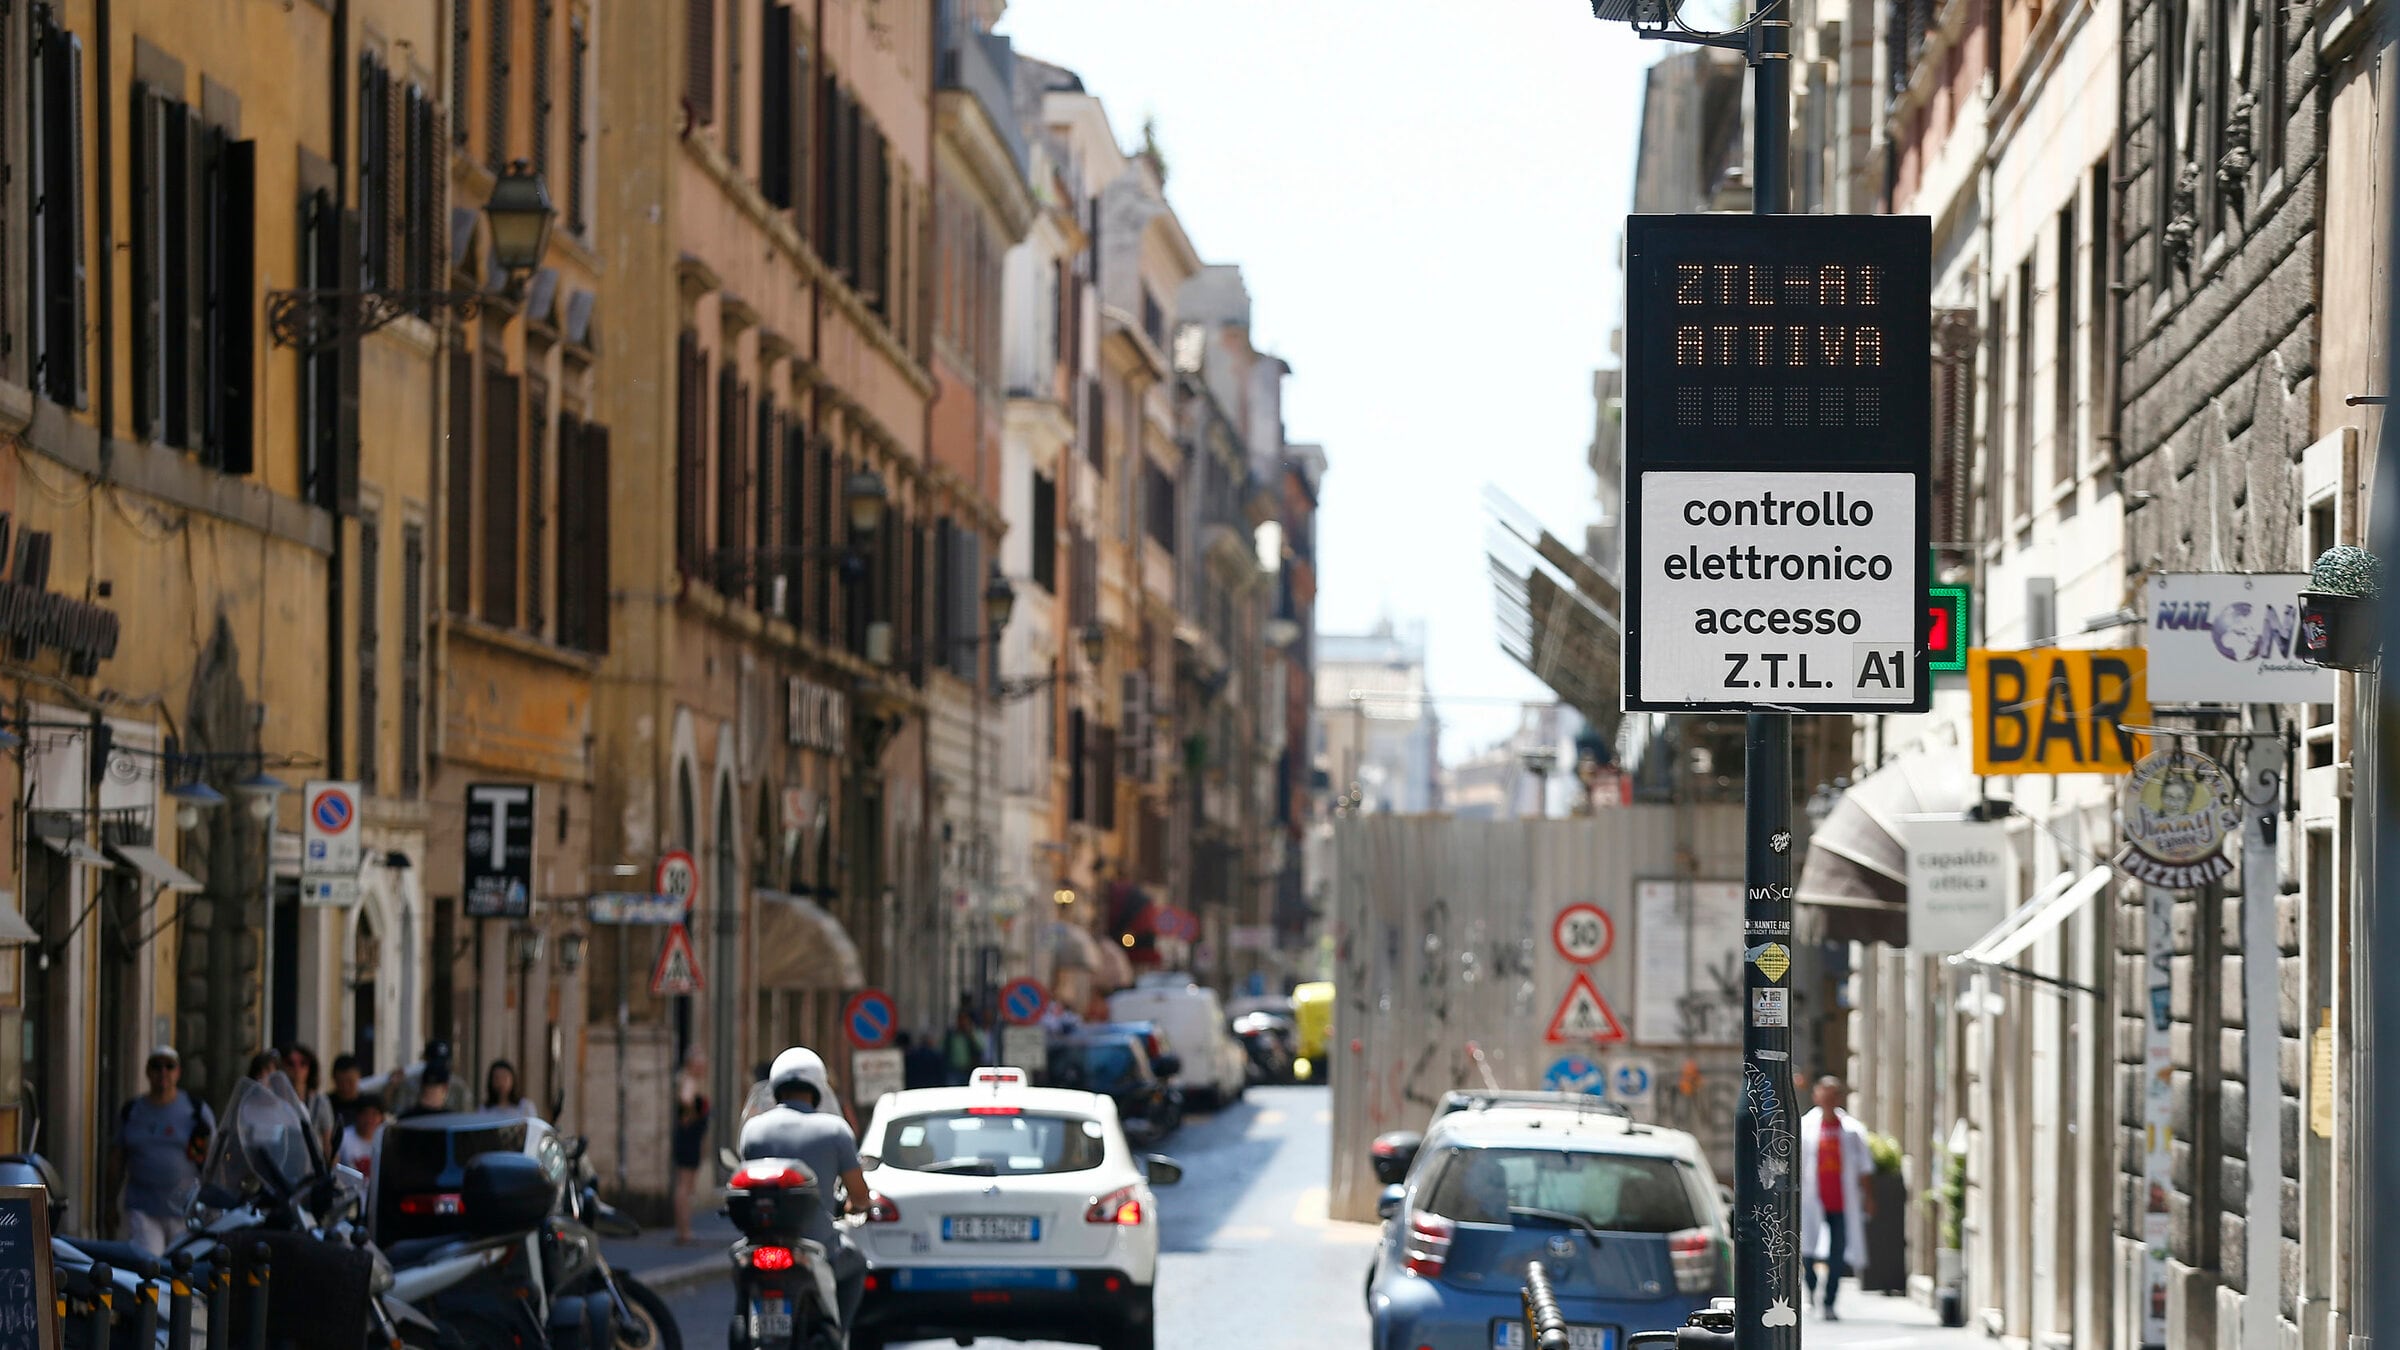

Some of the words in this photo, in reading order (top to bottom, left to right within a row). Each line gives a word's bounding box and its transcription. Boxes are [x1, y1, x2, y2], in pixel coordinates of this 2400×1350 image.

[1677, 325, 1880, 367] ATTIVA
[1683, 491, 1874, 527] controllo
[1664, 545, 1893, 581] elettronico
[1695, 607, 1861, 635] accesso
[2156, 601, 2213, 630] NAIL
[1724, 653, 1834, 689] Z.T.L.
[1856, 651, 1905, 689] A1
[1987, 657, 2134, 763] BAR
[472, 788, 529, 870] T
[2125, 798, 2239, 848] Jimmy's
[2122, 852, 2231, 888] PIZZERIA
[1570, 921, 1600, 946] 30
